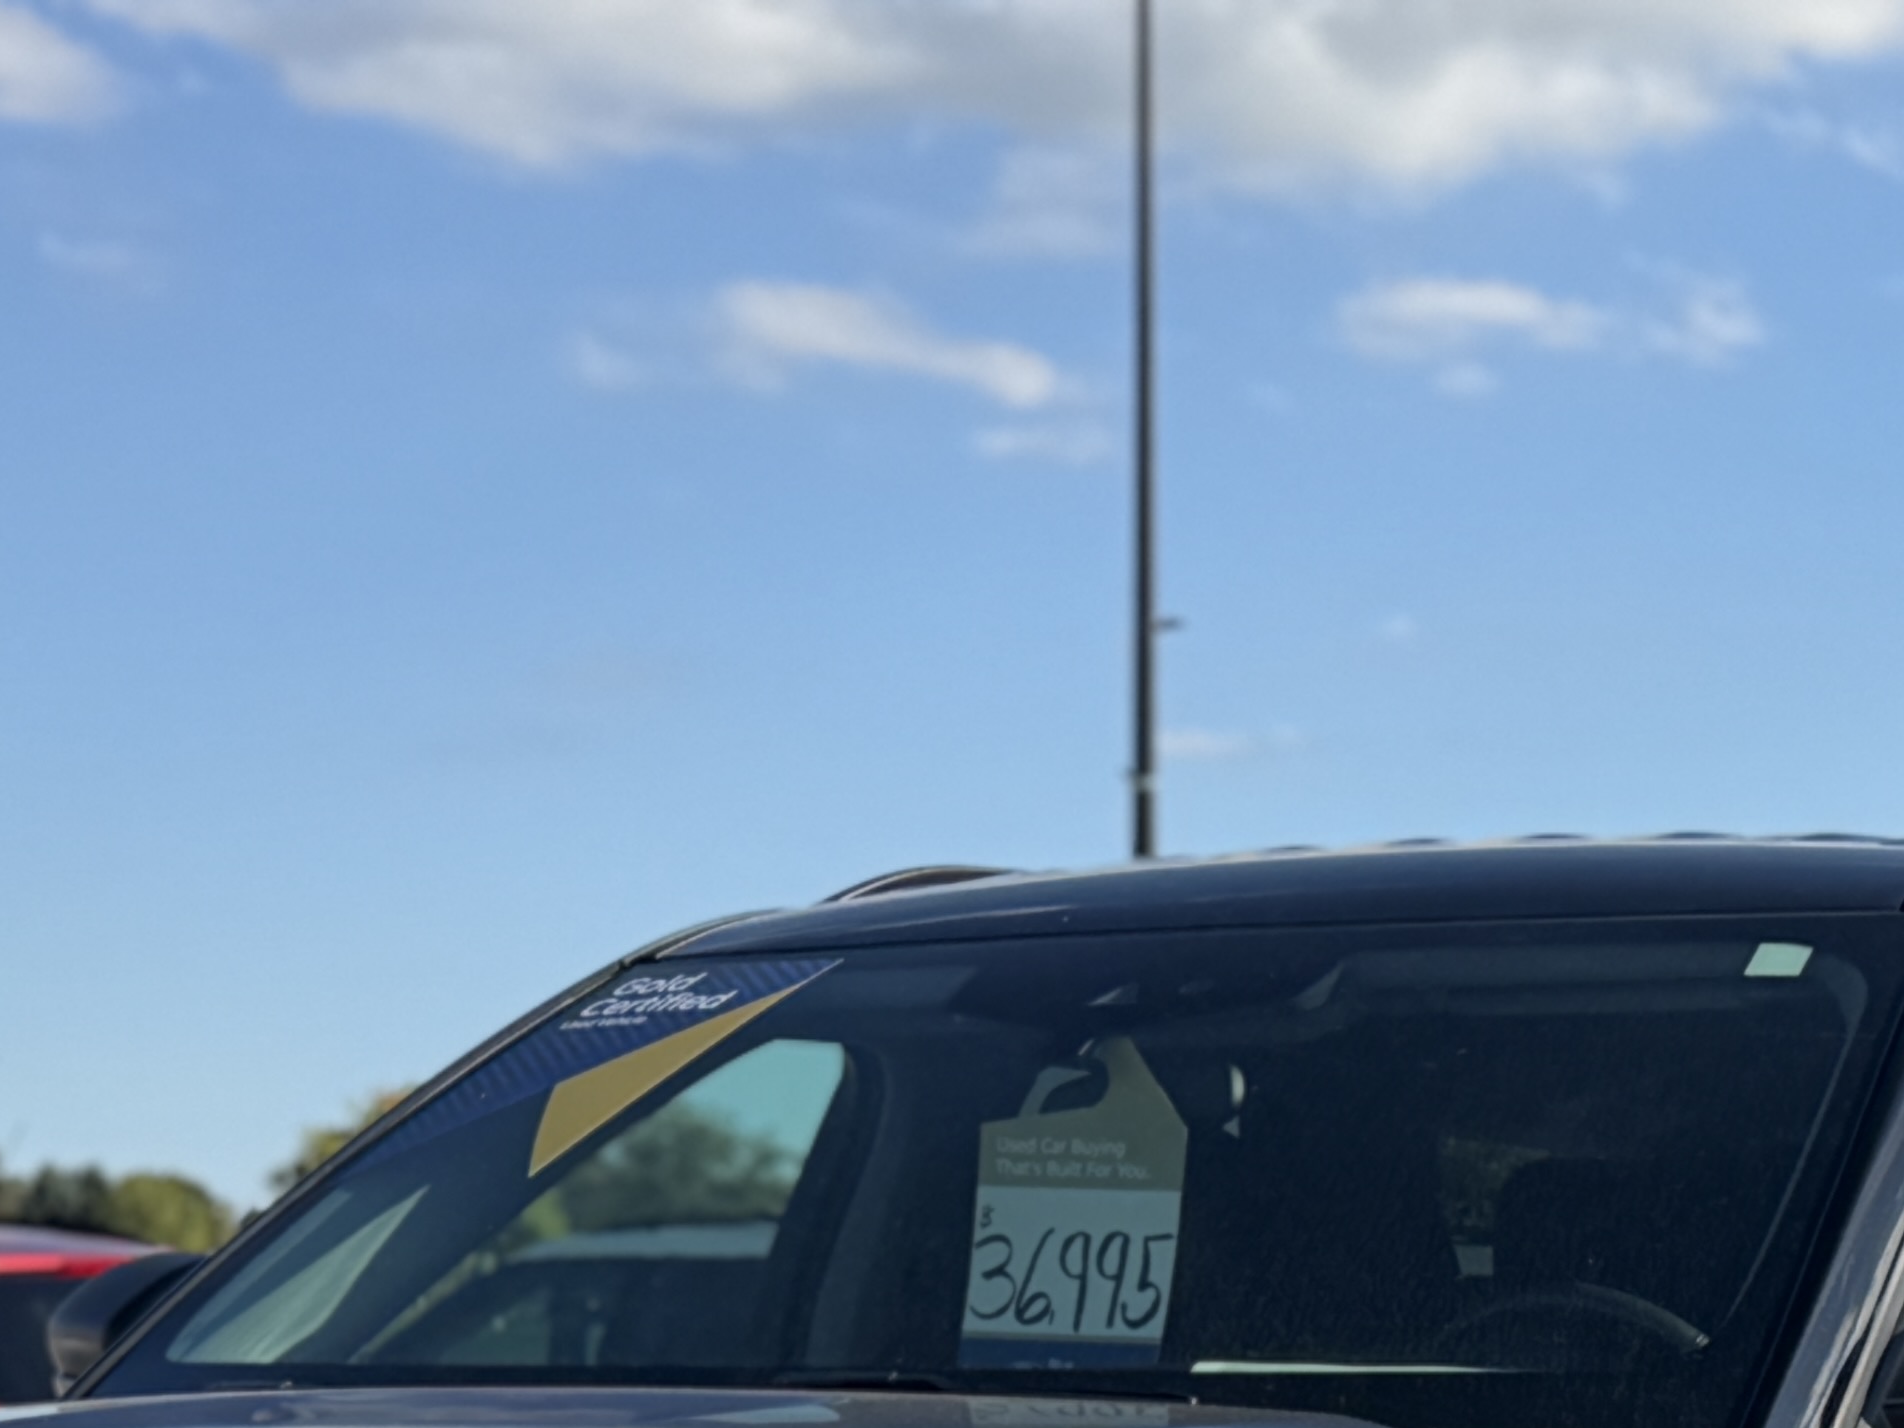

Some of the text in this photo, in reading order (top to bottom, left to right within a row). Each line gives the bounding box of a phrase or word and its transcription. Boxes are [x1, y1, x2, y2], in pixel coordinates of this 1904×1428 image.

[613, 971, 709, 997] Gold
[580, 989, 739, 1017] Certified
[995, 1136, 1127, 1160] Used Car Buying
[995, 1157, 1043, 1177] That's
[1046, 1160, 1083, 1178] Built
[1086, 1161, 1113, 1178] For
